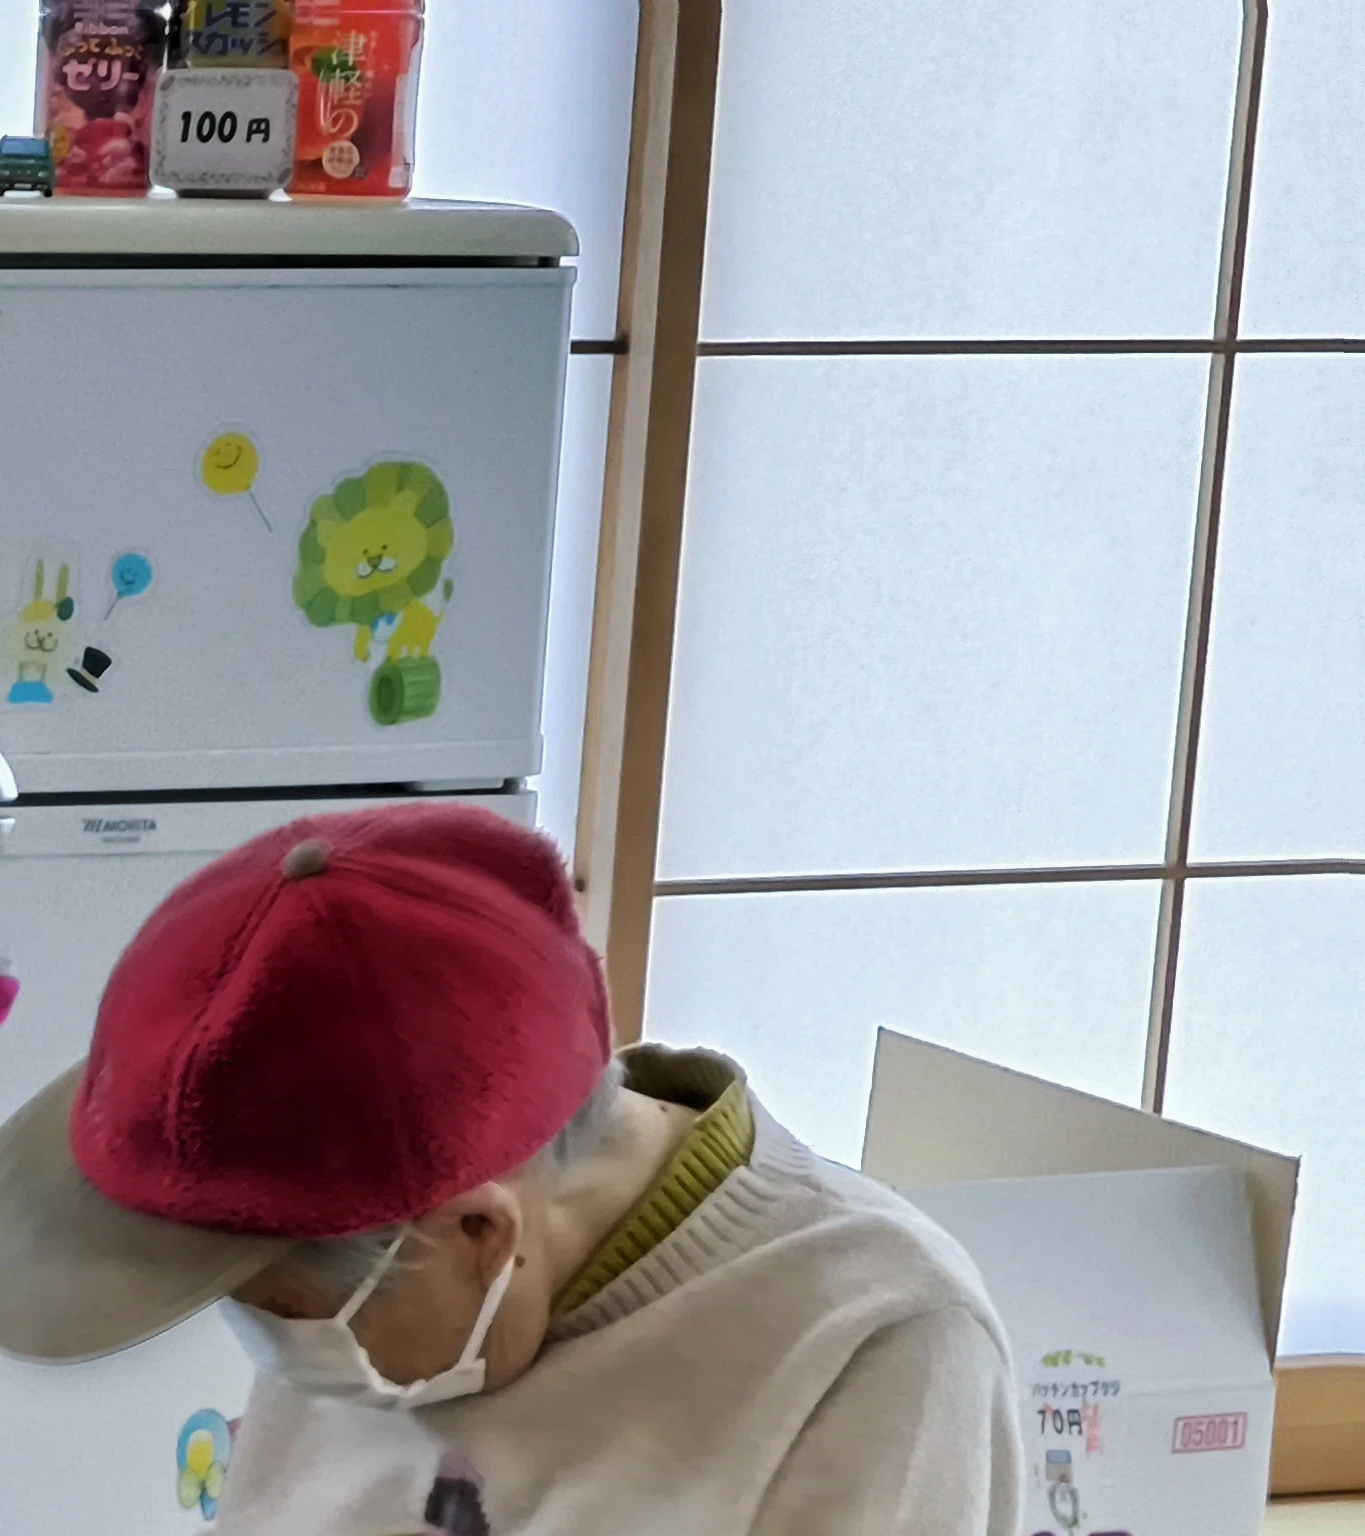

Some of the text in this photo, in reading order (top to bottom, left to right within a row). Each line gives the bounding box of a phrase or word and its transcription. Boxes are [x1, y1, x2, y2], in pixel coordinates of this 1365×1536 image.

[62, 58, 139, 91] ゼリー
[180, 110, 271, 144] 100円
[1037, 1408, 1083, 1436] 70円
[1181, 1419, 1239, 1448] 05001
